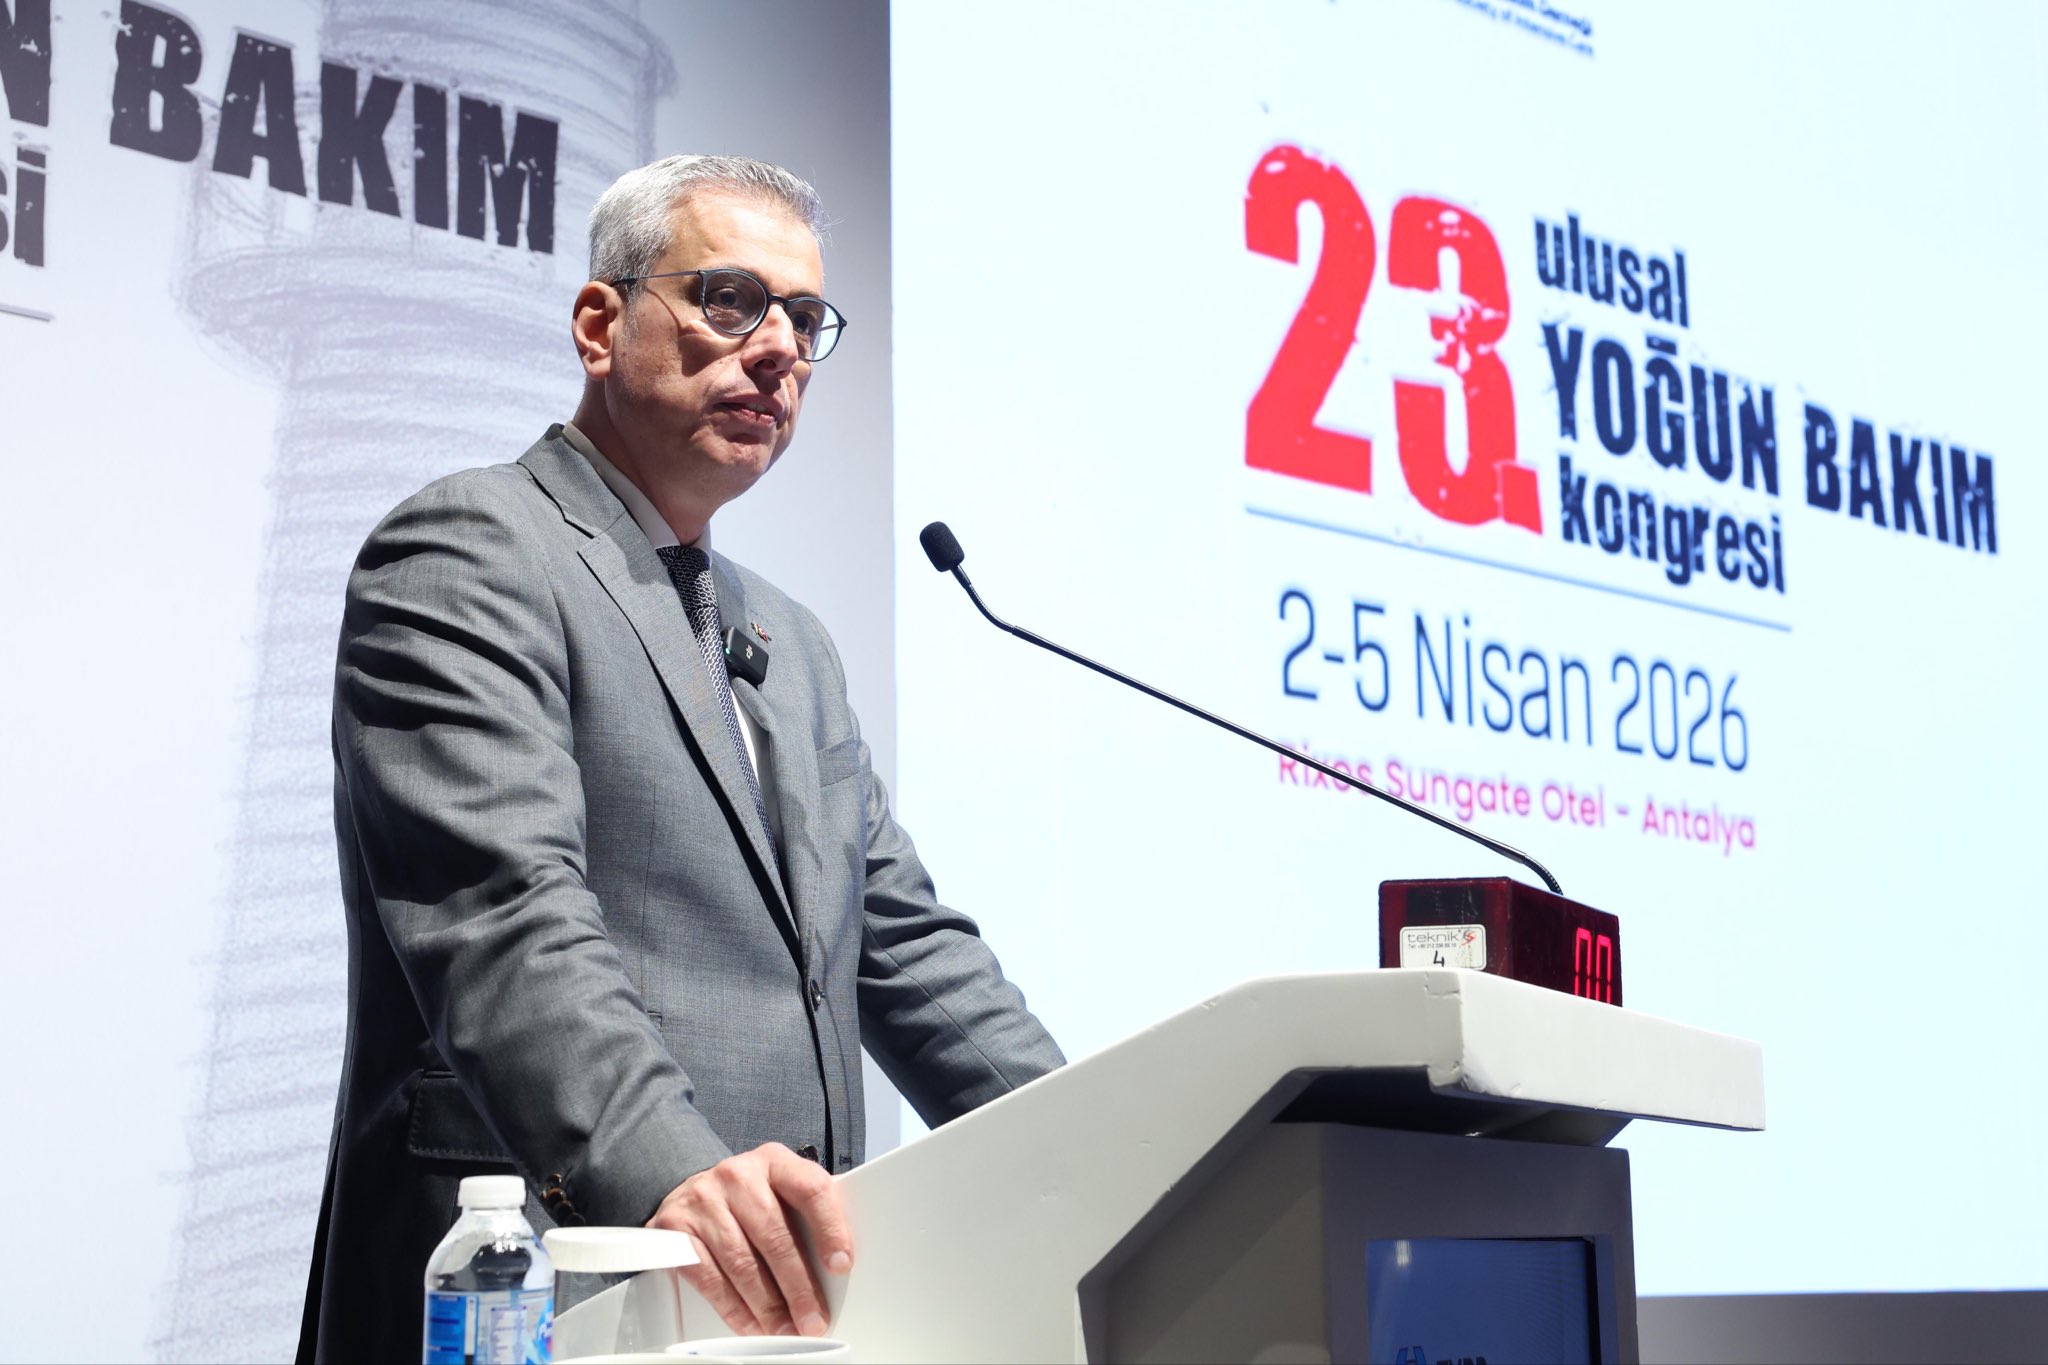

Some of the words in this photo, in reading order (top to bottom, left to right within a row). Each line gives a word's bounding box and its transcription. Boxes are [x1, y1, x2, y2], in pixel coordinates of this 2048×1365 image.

[110, 0, 560, 255] BAKIM
[0, 147, 47, 268] i
[1535, 214, 1691, 329] ulusal
[1542, 323, 1780, 498] YOĞUN
[1804, 404, 1999, 556] BAKIM
[1560, 455, 1787, 596] kongresi
[1279, 588, 1391, 713] 2-5
[1415, 614, 1593, 747] Nisan
[1612, 655, 1749, 773] 2026
[1386, 759, 1532, 824] Sungate
[1542, 783, 1606, 828] Otel
[1642, 797, 1757, 857] Antalya
[1408, 931, 1459, 943] teknik
[1433, 950, 1445, 967] 4
